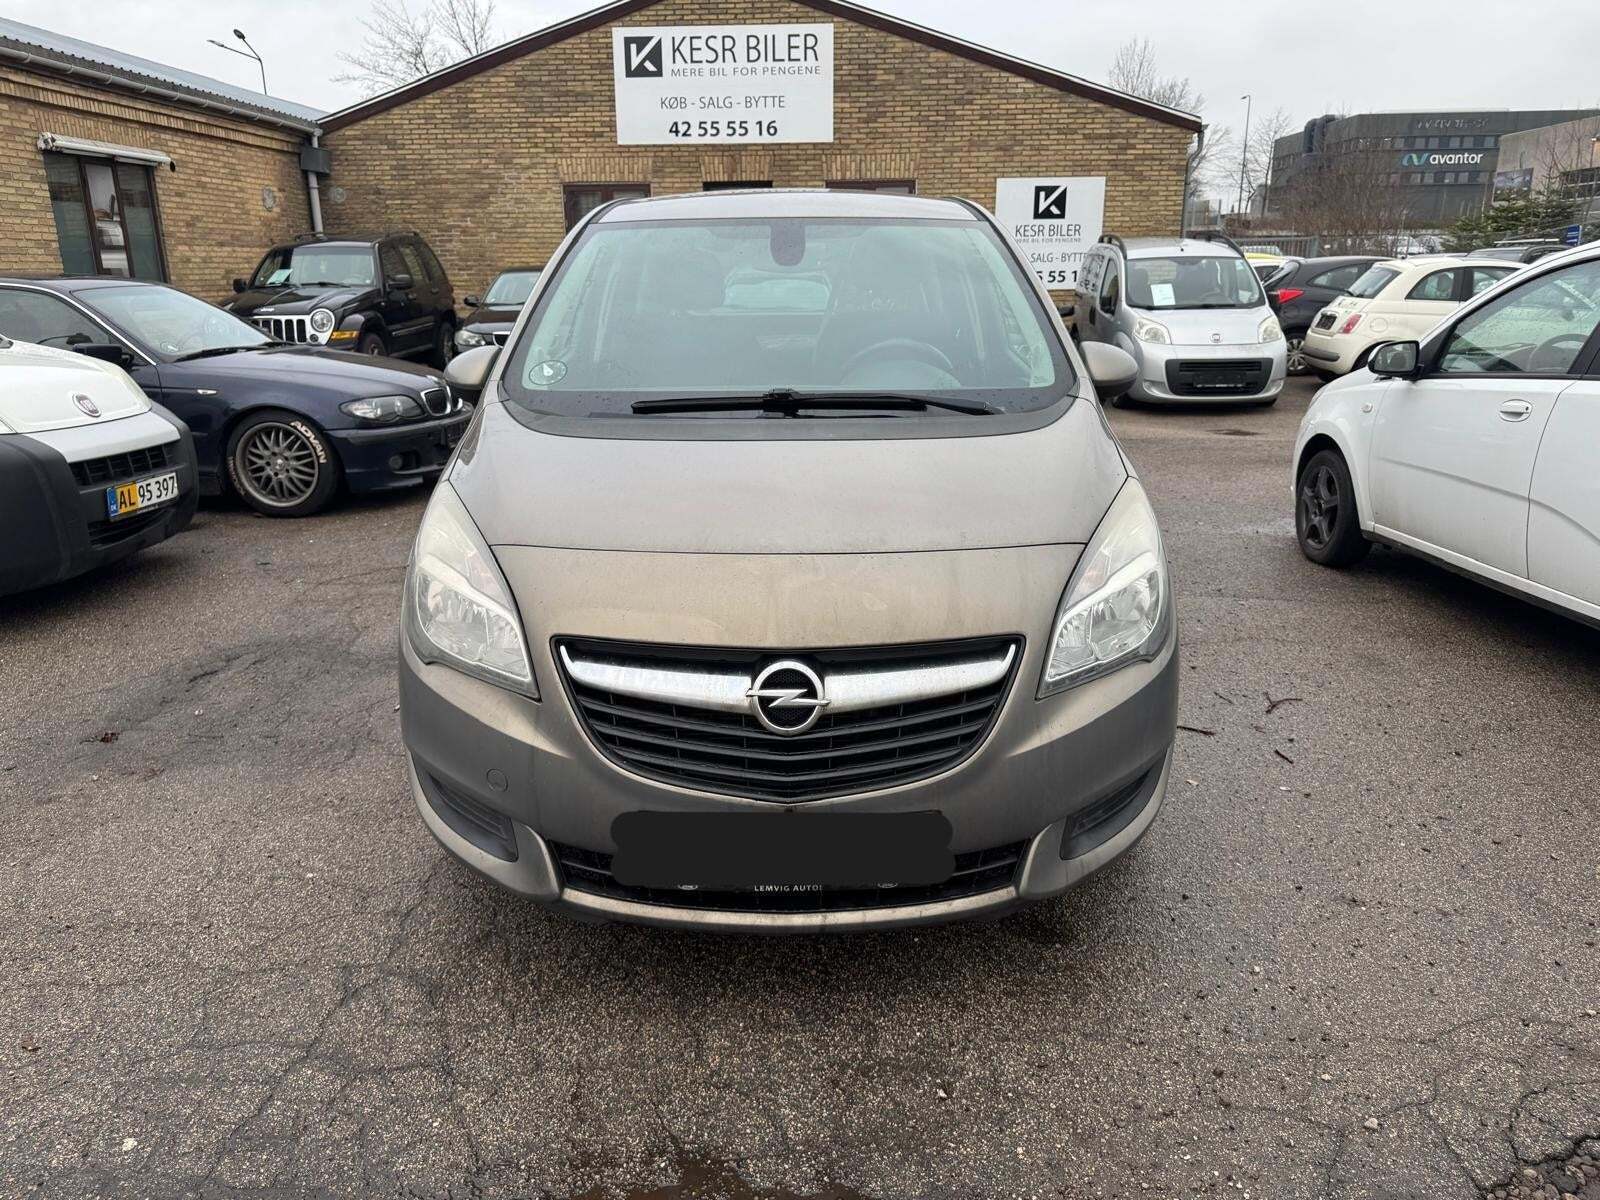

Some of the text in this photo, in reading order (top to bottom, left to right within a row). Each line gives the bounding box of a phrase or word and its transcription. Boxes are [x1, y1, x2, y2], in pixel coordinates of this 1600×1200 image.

[671, 33, 819, 65] KESR BILER
[670, 65, 821, 77] MERE BIL FOR PENGENE
[660, 96, 688, 110] KØB
[699, 96, 733, 109] SALG
[744, 95, 786, 108] BYTTE
[668, 120, 778, 137] 42 55 55 16
[1429, 152, 1484, 165] avantor
[1015, 223, 1082, 238] KESR BILER
[1030, 252, 1054, 263] SALG
[1047, 270, 1066, 283] 55
[290, 421, 327, 464] ADVAN
[119, 489, 136, 509] AL
[138, 483, 153, 504] 95
[155, 475, 175, 499] 397
